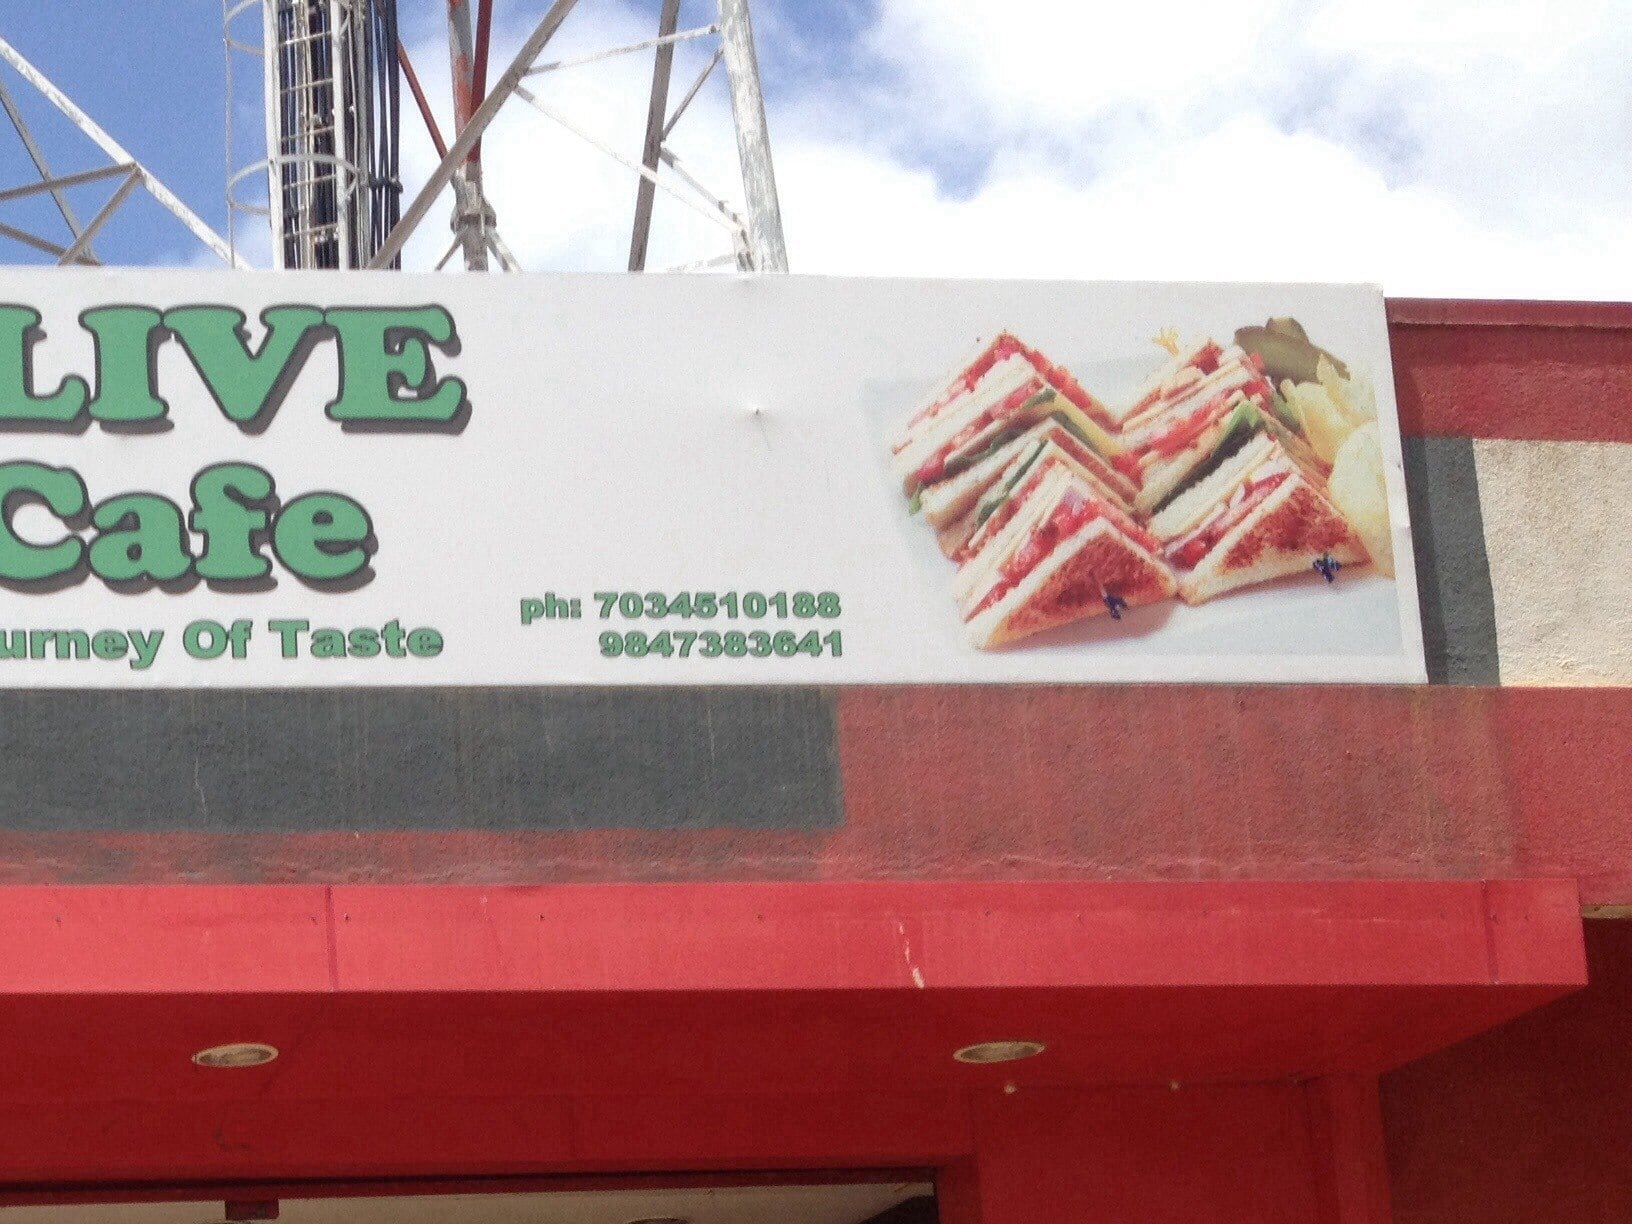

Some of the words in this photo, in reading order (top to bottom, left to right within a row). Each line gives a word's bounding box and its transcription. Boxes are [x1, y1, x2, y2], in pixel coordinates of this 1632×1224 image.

[520, 592, 582, 626] ph:
[594, 591, 842, 619] 7034510188
[182, 618, 254, 660] Of
[267, 620, 444, 660] Taste
[598, 630, 843, 658] 9847383641
